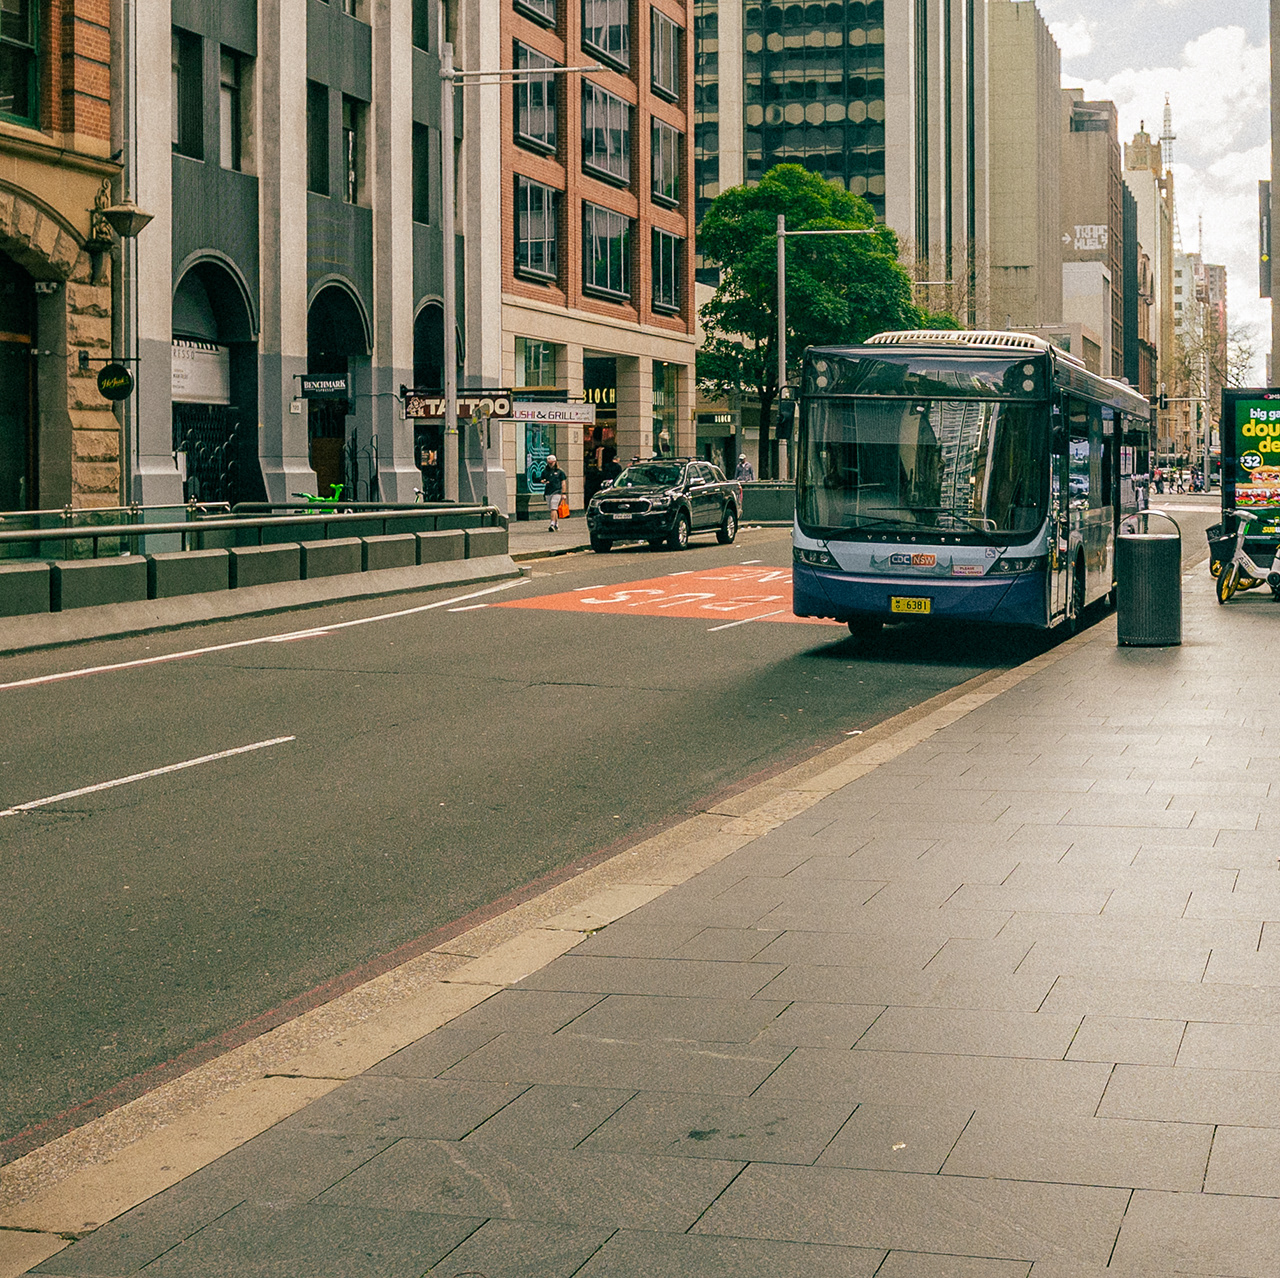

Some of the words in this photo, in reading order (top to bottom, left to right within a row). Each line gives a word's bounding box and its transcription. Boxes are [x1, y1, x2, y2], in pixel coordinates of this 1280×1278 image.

[304, 380, 346, 389] BENCHMARK
[536, 410, 547, 420] &
[548, 411, 575, 420] GRILL
[1249, 408, 1267, 421] big
[1240, 456, 1261, 467] $32
[891, 555, 910, 564] CDC
[912, 555, 935, 565] NSW
[906, 601, 927, 610] 6381
